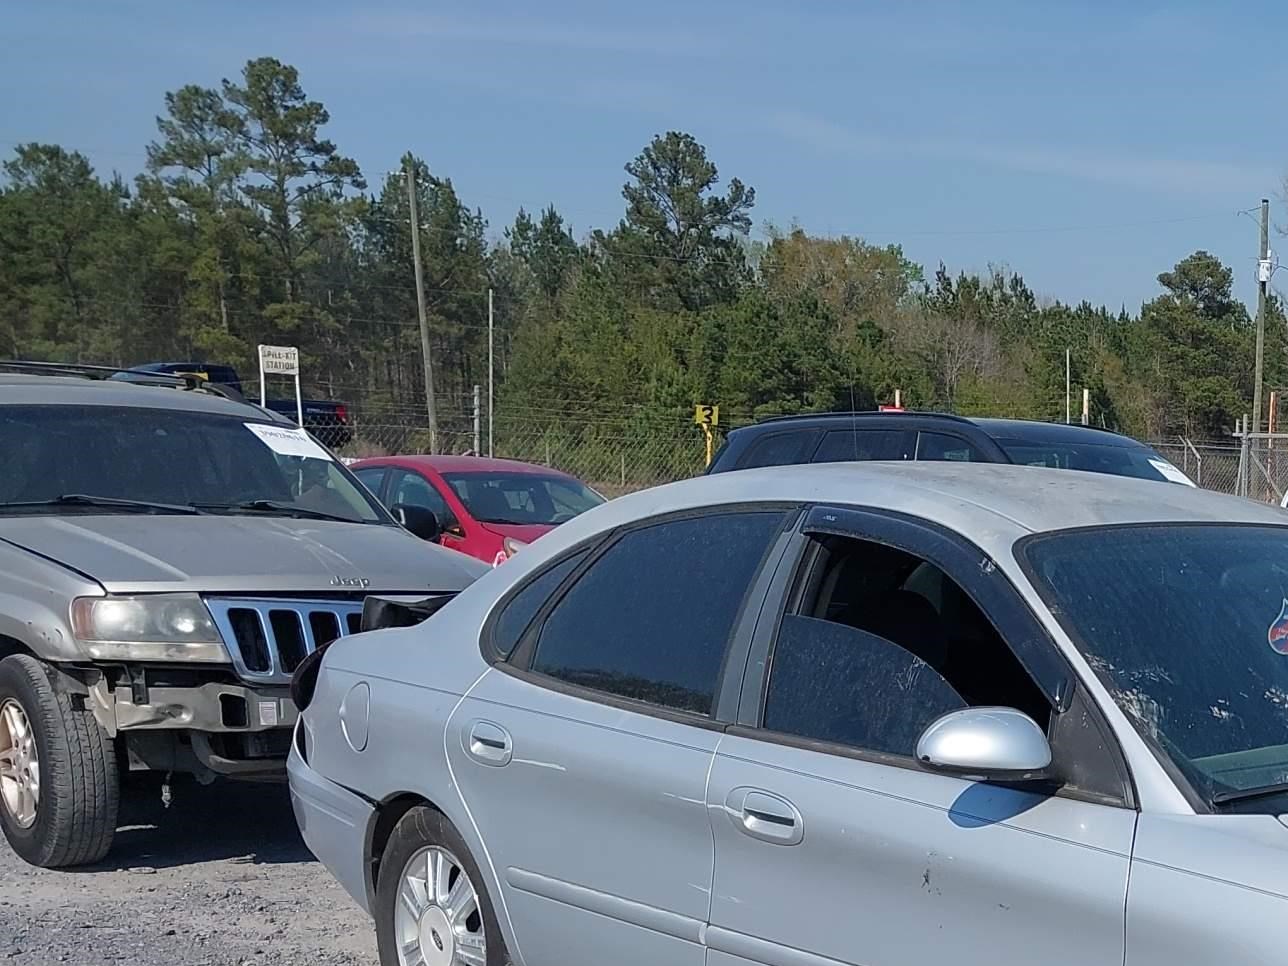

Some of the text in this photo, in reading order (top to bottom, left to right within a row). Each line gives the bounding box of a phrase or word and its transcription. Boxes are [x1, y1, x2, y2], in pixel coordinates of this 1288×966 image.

[264, 360, 295, 369] STATION
[701, 406, 713, 423] 3
[330, 575, 370, 588] Jeep
